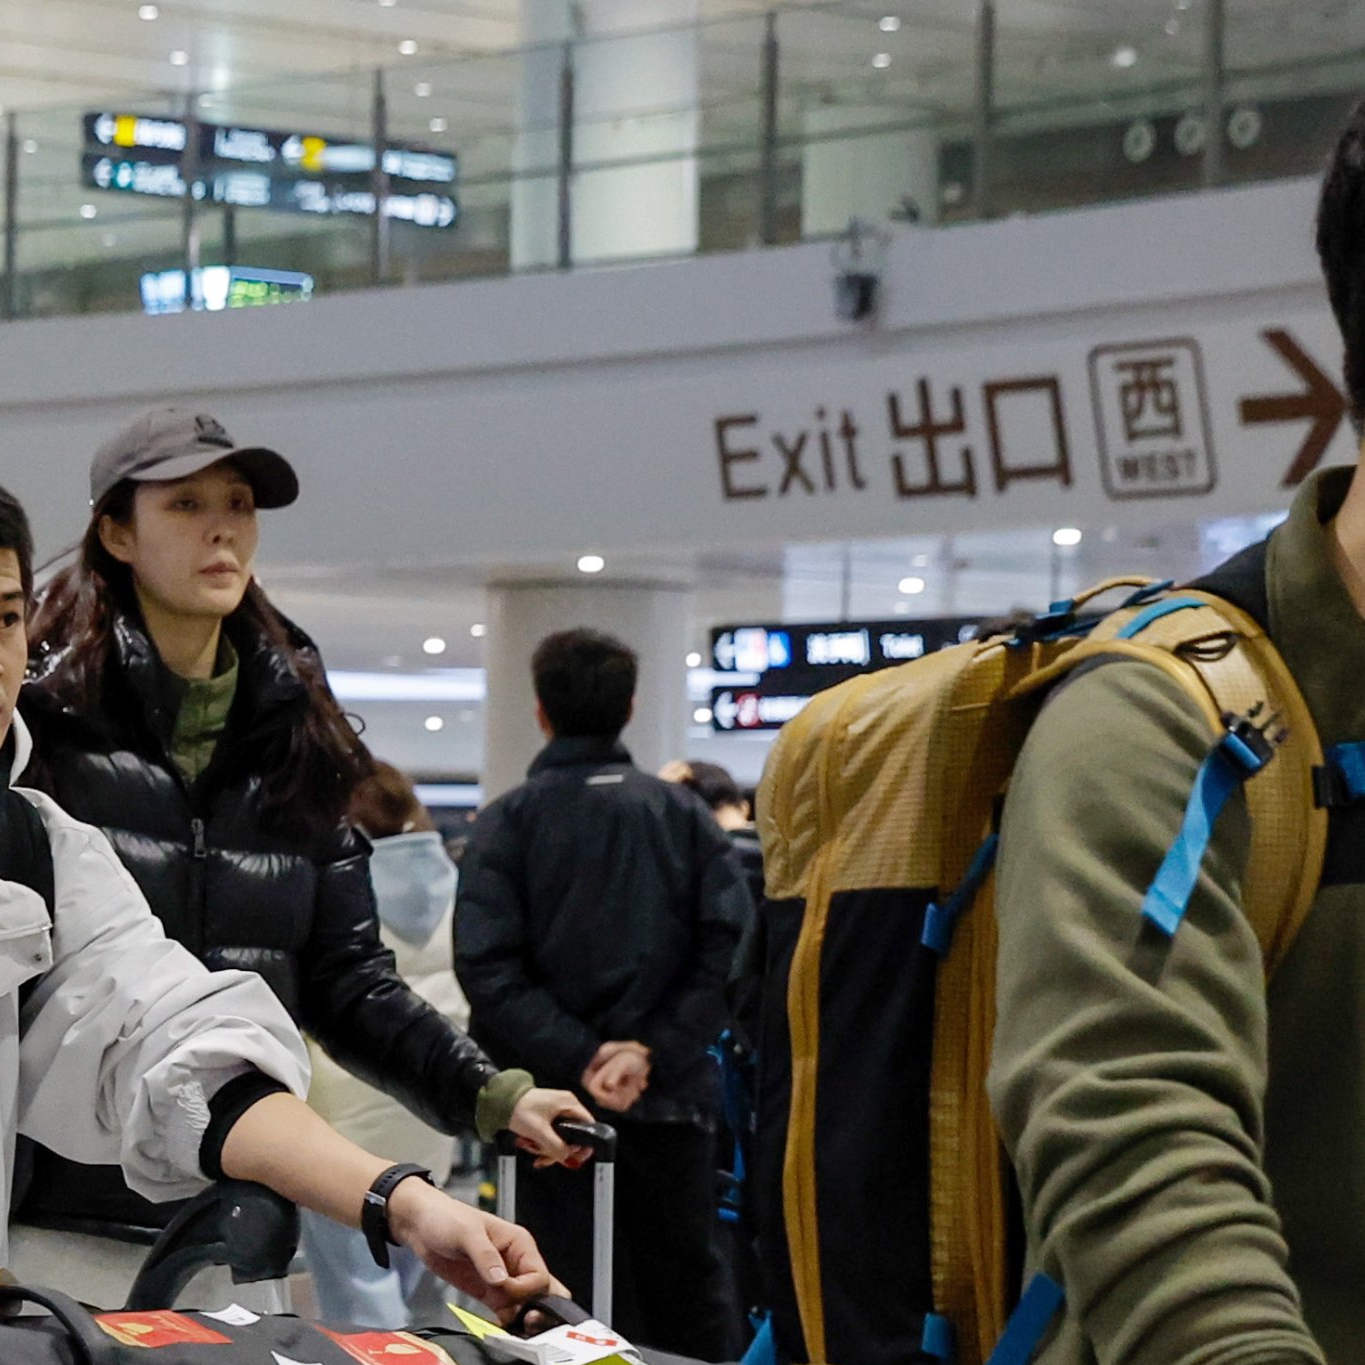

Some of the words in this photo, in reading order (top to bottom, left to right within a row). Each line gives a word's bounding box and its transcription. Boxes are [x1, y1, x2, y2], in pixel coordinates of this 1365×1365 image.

[715, 406, 866, 498] Exit
[888, 376, 1073, 497] 出口
[1113, 356, 1183, 443] 西
[1115, 448, 1199, 483] WEST
